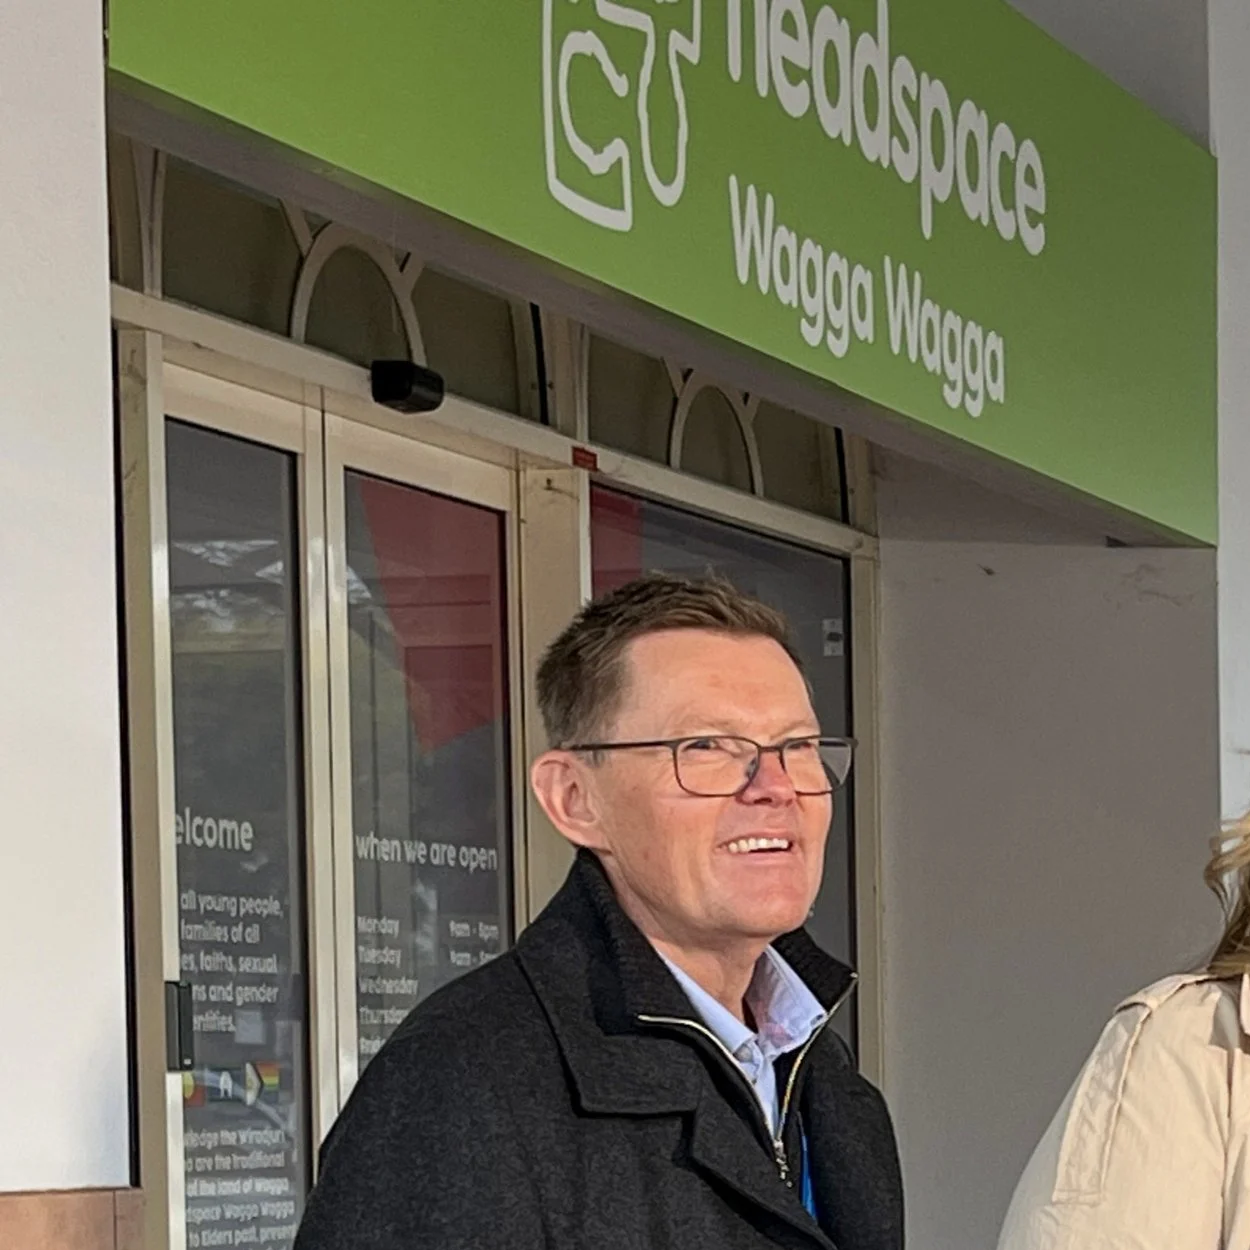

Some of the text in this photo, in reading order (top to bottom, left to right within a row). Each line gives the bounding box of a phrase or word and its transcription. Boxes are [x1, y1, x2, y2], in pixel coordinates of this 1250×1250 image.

[729, 174, 1006, 418] Wagga Wagga
[356, 831, 497, 873] when we are open
[180, 889, 196, 910] all
[198, 894, 237, 917] young
[357, 916, 400, 939] Monday
[238, 953, 278, 973] sexual
[208, 981, 233, 1002] and
[235, 982, 279, 1006] gender
